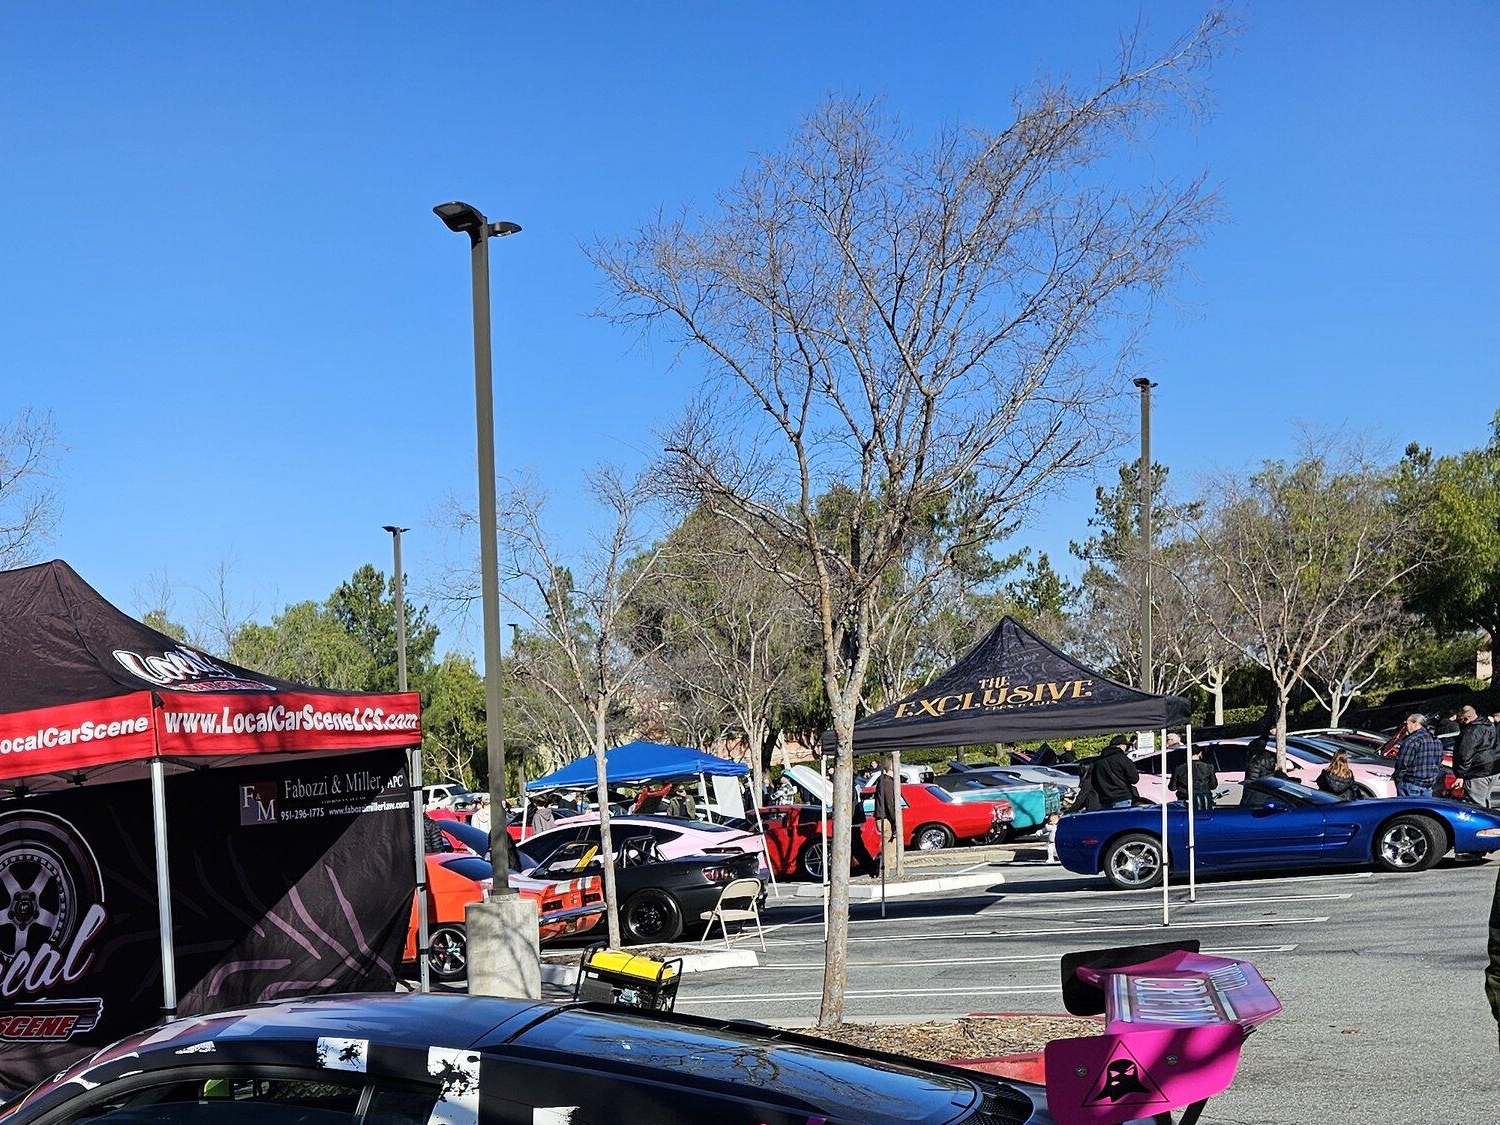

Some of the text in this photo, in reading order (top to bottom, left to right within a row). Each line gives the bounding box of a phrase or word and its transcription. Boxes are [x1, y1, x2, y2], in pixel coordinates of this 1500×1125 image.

[979, 676, 1010, 689] THE
[894, 680, 1093, 718] EXCLUSIVE
[164, 704, 419, 734] www.LocalCarSceneLCS.com
[284, 771, 404, 799] Fabozzi & Miller, APC
[280, 808, 325, 821] 951-296-1775
